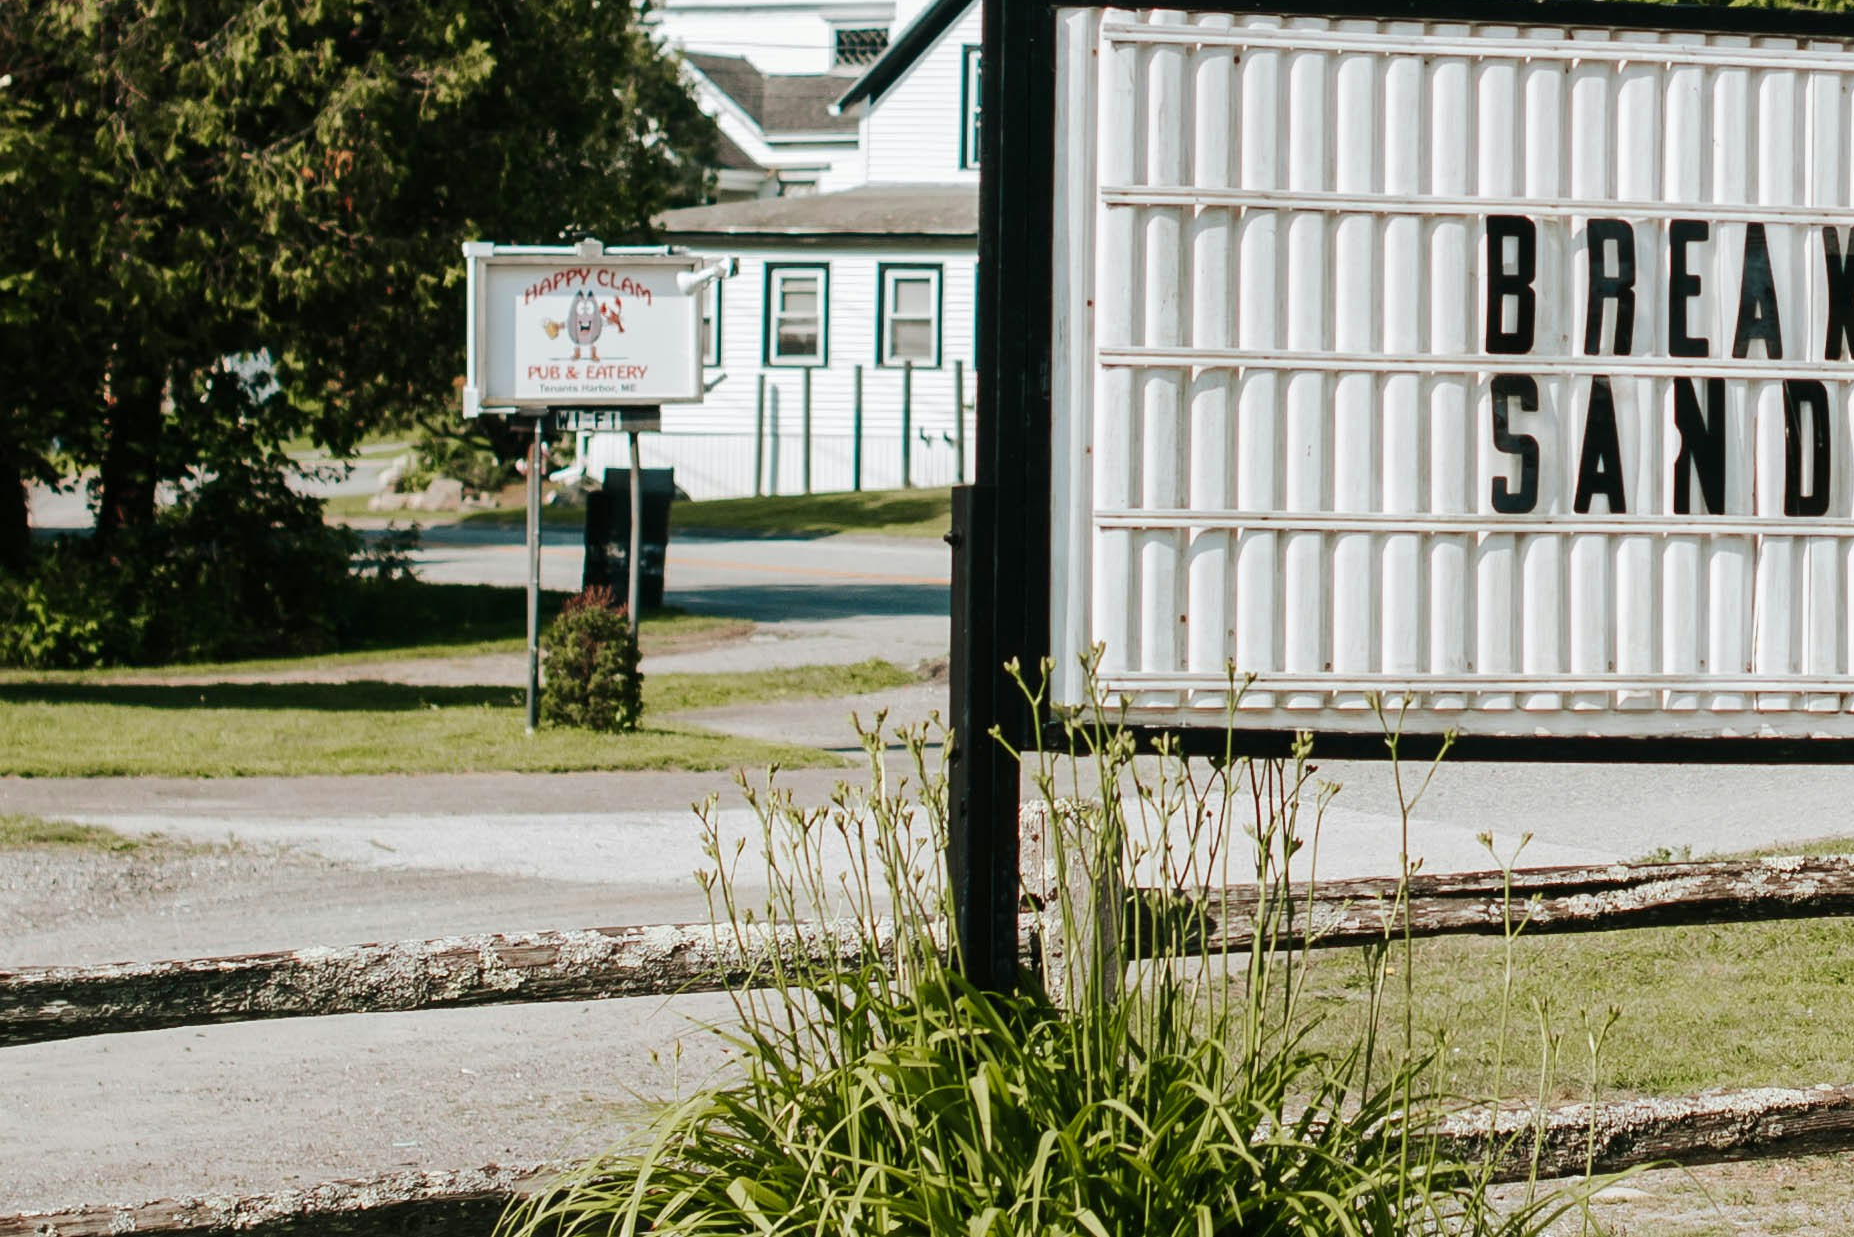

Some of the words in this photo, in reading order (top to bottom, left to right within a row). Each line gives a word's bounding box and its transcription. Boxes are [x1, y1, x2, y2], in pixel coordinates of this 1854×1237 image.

[525, 267, 592, 305] HAPPY
[597, 268, 652, 306] CLAM
[528, 365, 560, 380] PUB
[566, 366, 578, 380] &
[586, 365, 648, 380] EATERY
[540, 384, 578, 393] Tenants
[621, 384, 636, 393] ME
[557, 411, 617, 429] WI-FI
